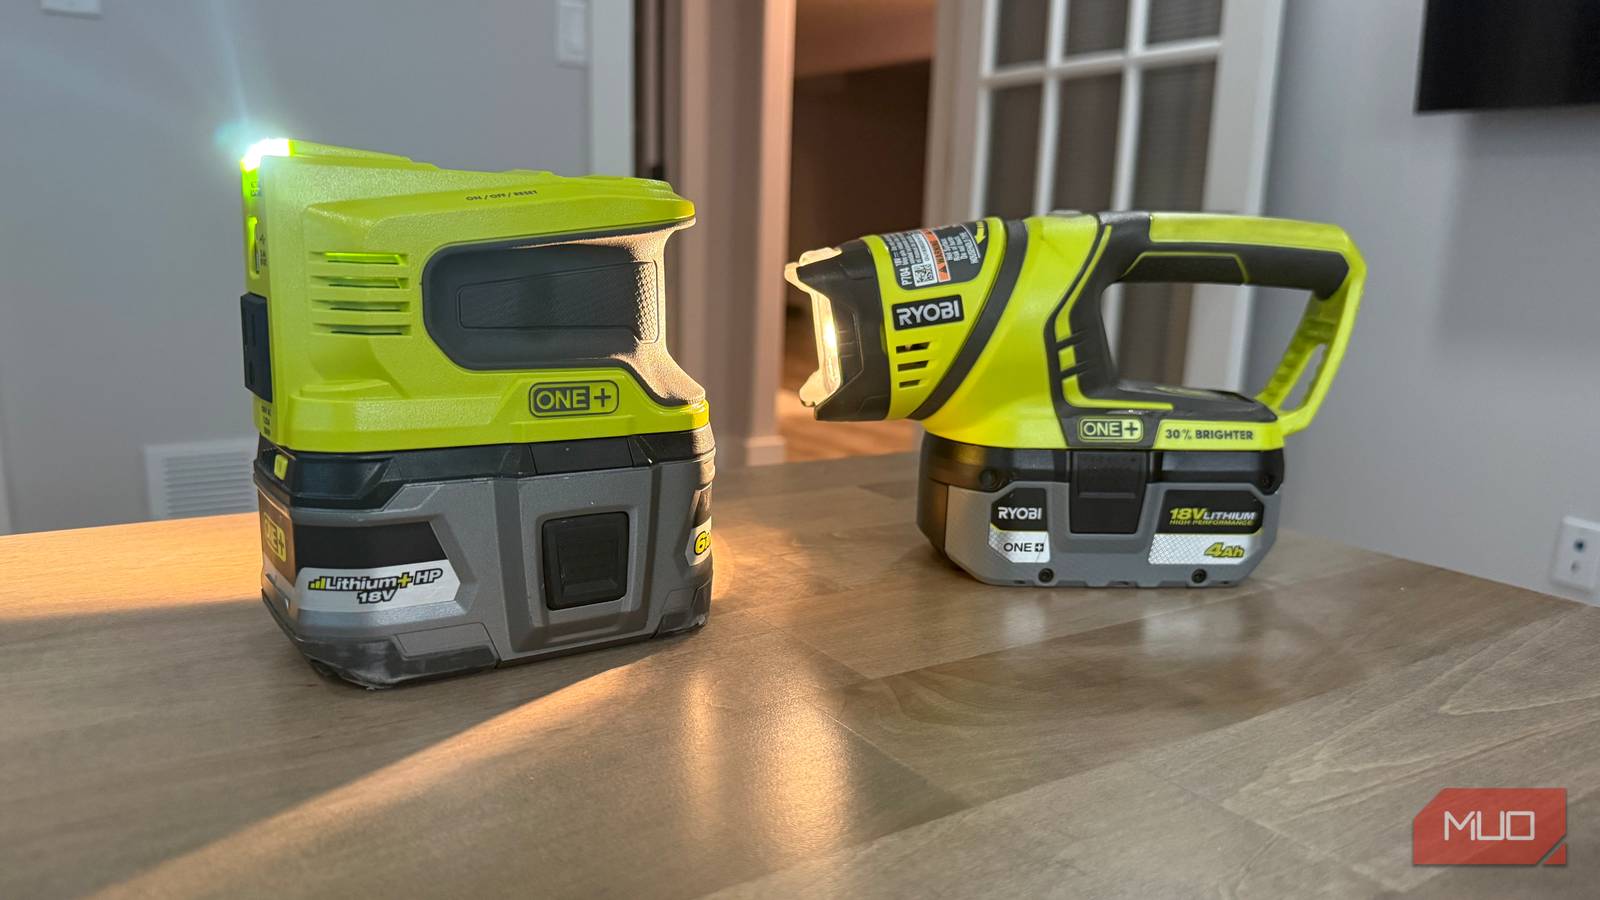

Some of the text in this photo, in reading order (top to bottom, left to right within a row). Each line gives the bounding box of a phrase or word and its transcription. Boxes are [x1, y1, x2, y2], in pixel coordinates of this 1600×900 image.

[896, 300, 960, 326] RYOBI
[536, 387, 612, 410] ONE+
[1083, 421, 1138, 437] ONE+
[1195, 430, 1254, 441] BRIGHTER
[997, 507, 1043, 520] RYOBI
[1193, 519, 1255, 527] PERFORMANCE
[1204, 542, 1245, 558] 4Ah
[413, 568, 444, 586] HP
[357, 588, 398, 604] 18V
